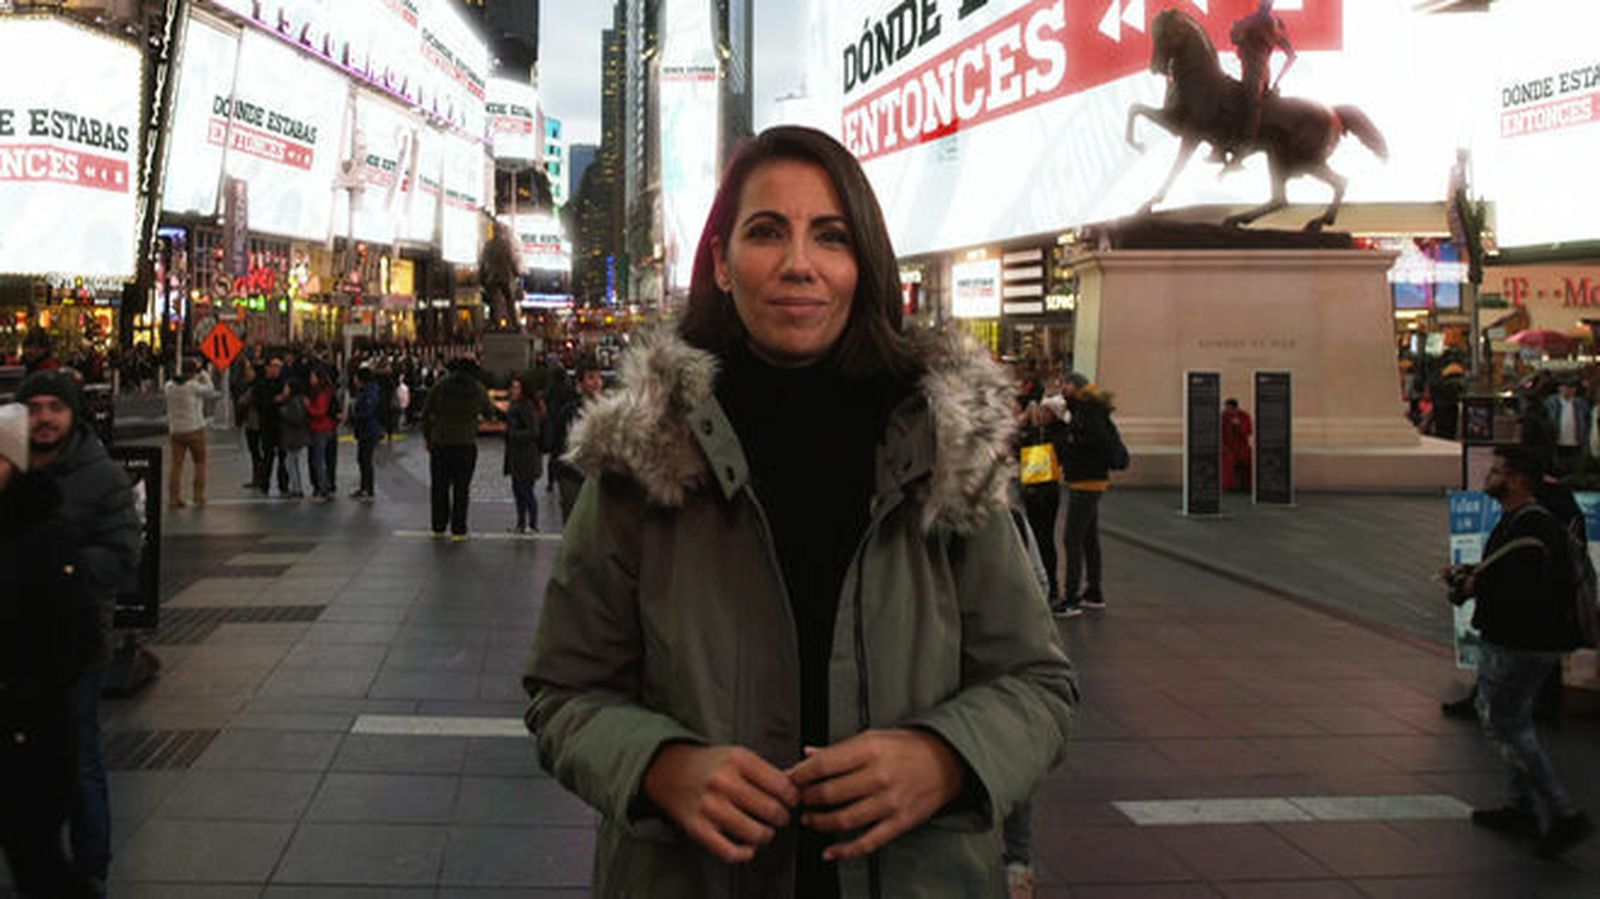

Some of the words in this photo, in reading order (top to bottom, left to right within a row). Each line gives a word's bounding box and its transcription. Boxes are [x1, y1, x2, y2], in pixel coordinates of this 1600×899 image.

[843, 0, 943, 94] DÓNDE
[843, 0, 1067, 158] ENTONCES
[28, 109, 129, 152] ESTABAS
[267, 110, 317, 144] ESTABAS
[1503, 97, 1592, 136] ENTONCES
